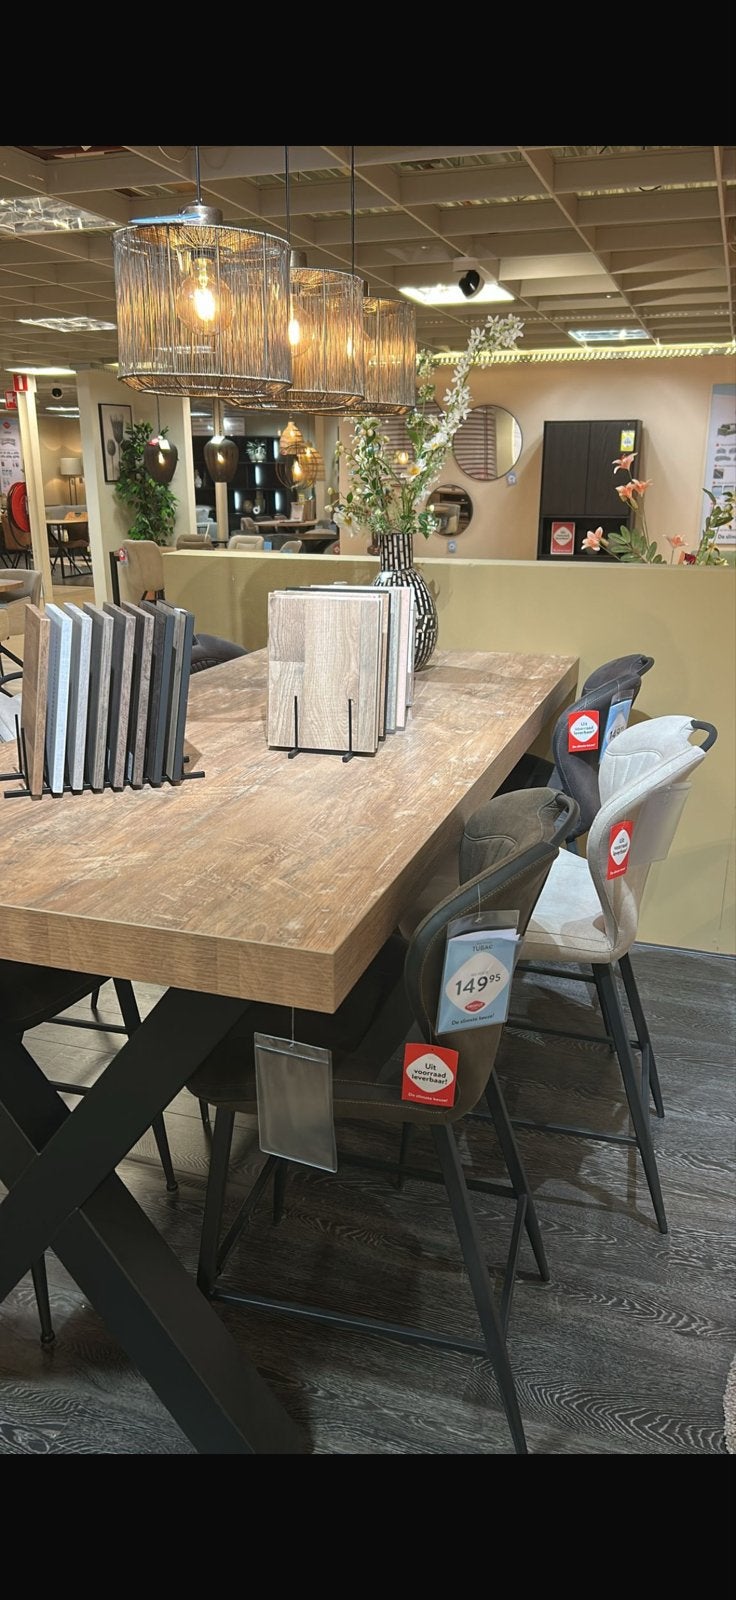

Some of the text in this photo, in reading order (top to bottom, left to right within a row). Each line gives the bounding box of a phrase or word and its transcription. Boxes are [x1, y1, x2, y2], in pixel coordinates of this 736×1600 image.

[425, 1063, 437, 1071] Uit
[413, 1069, 447, 1079] voorraad
[411, 1074, 448, 1085] leverbaar!
